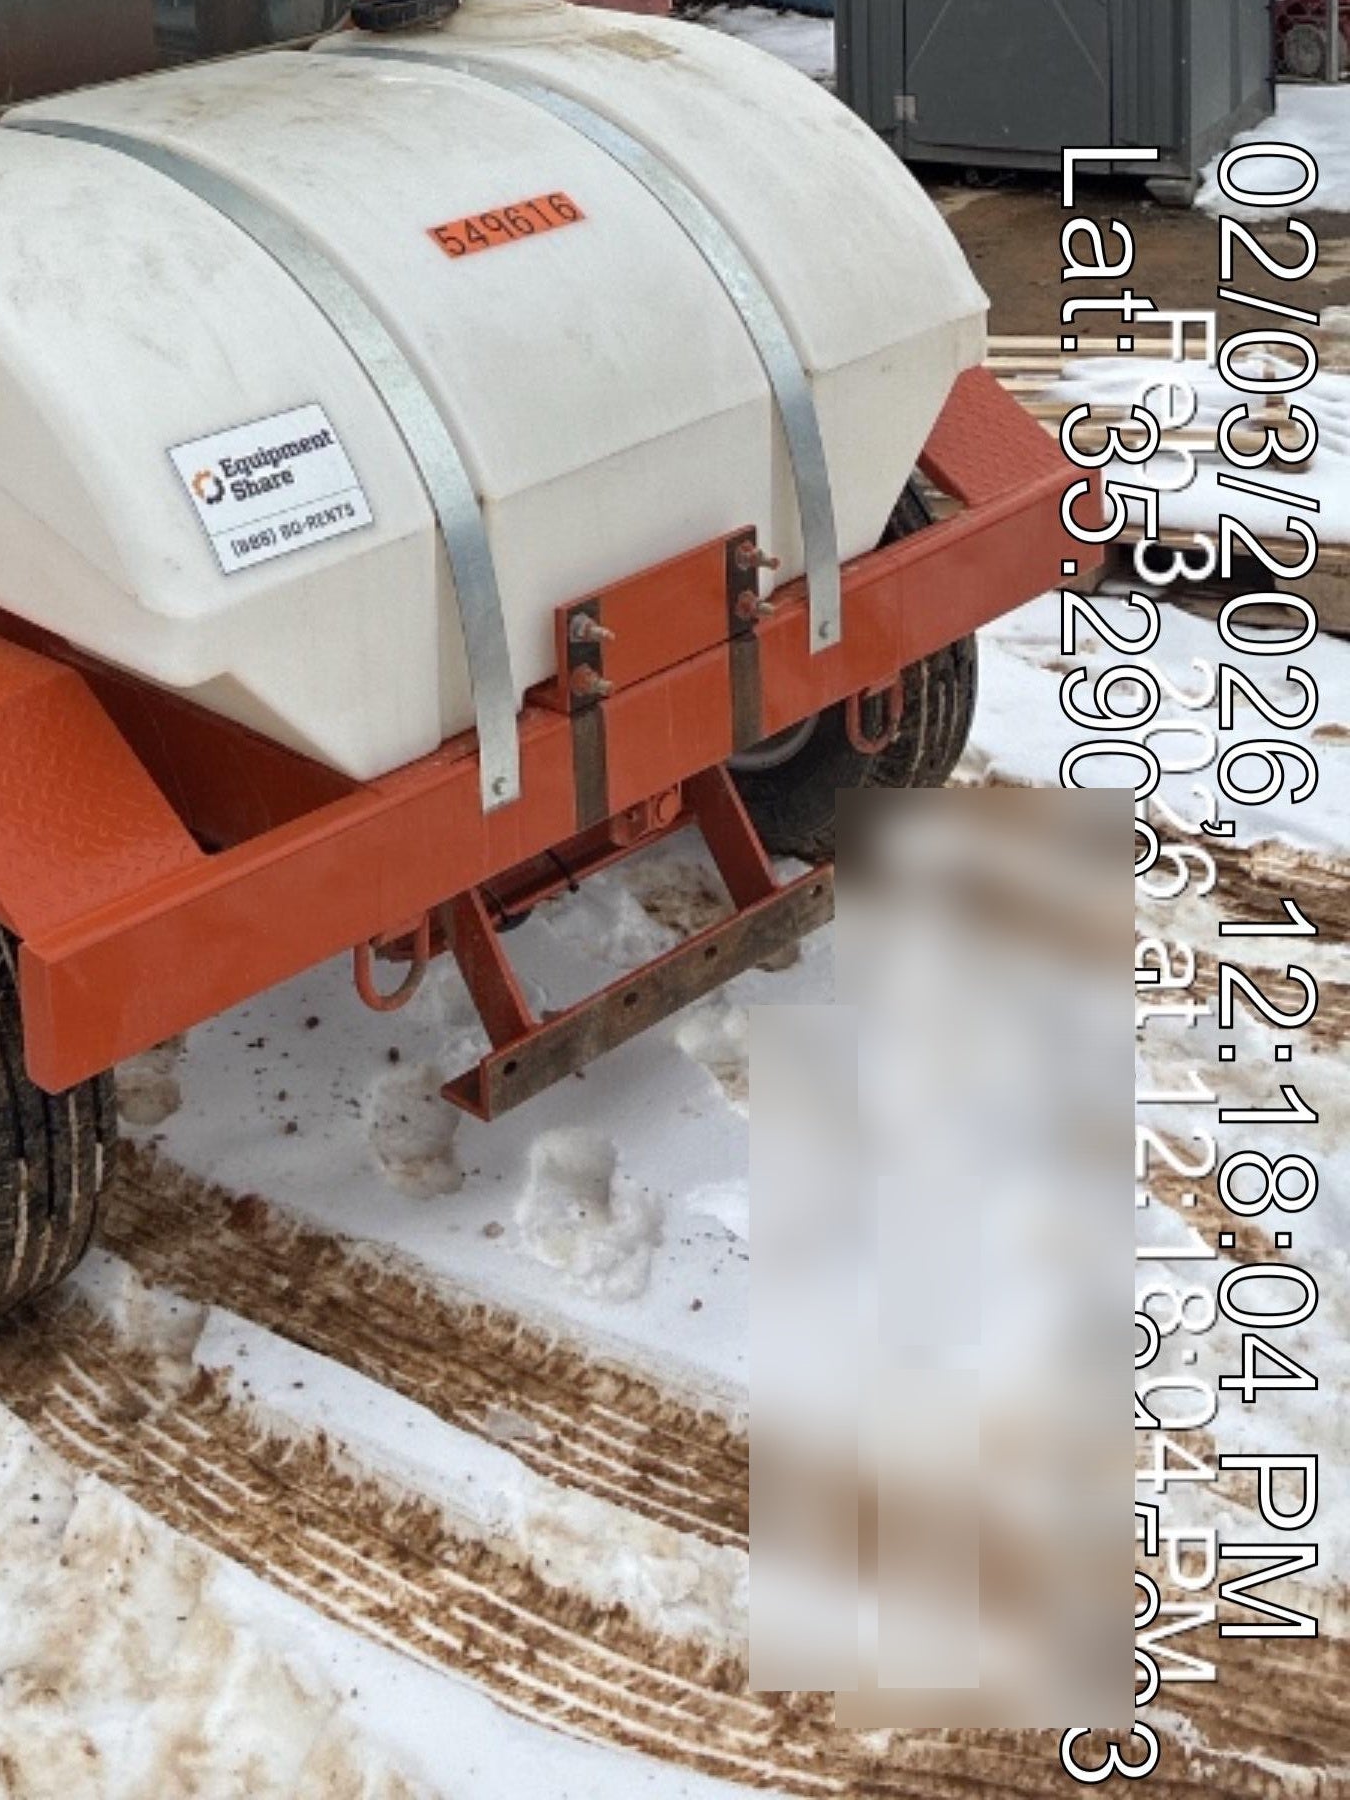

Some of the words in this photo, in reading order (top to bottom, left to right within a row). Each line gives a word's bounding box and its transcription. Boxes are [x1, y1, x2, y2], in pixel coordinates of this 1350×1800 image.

[433, 193, 578, 256] 549616
[218, 427, 335, 478] Equipment
[230, 469, 295, 502] Share
